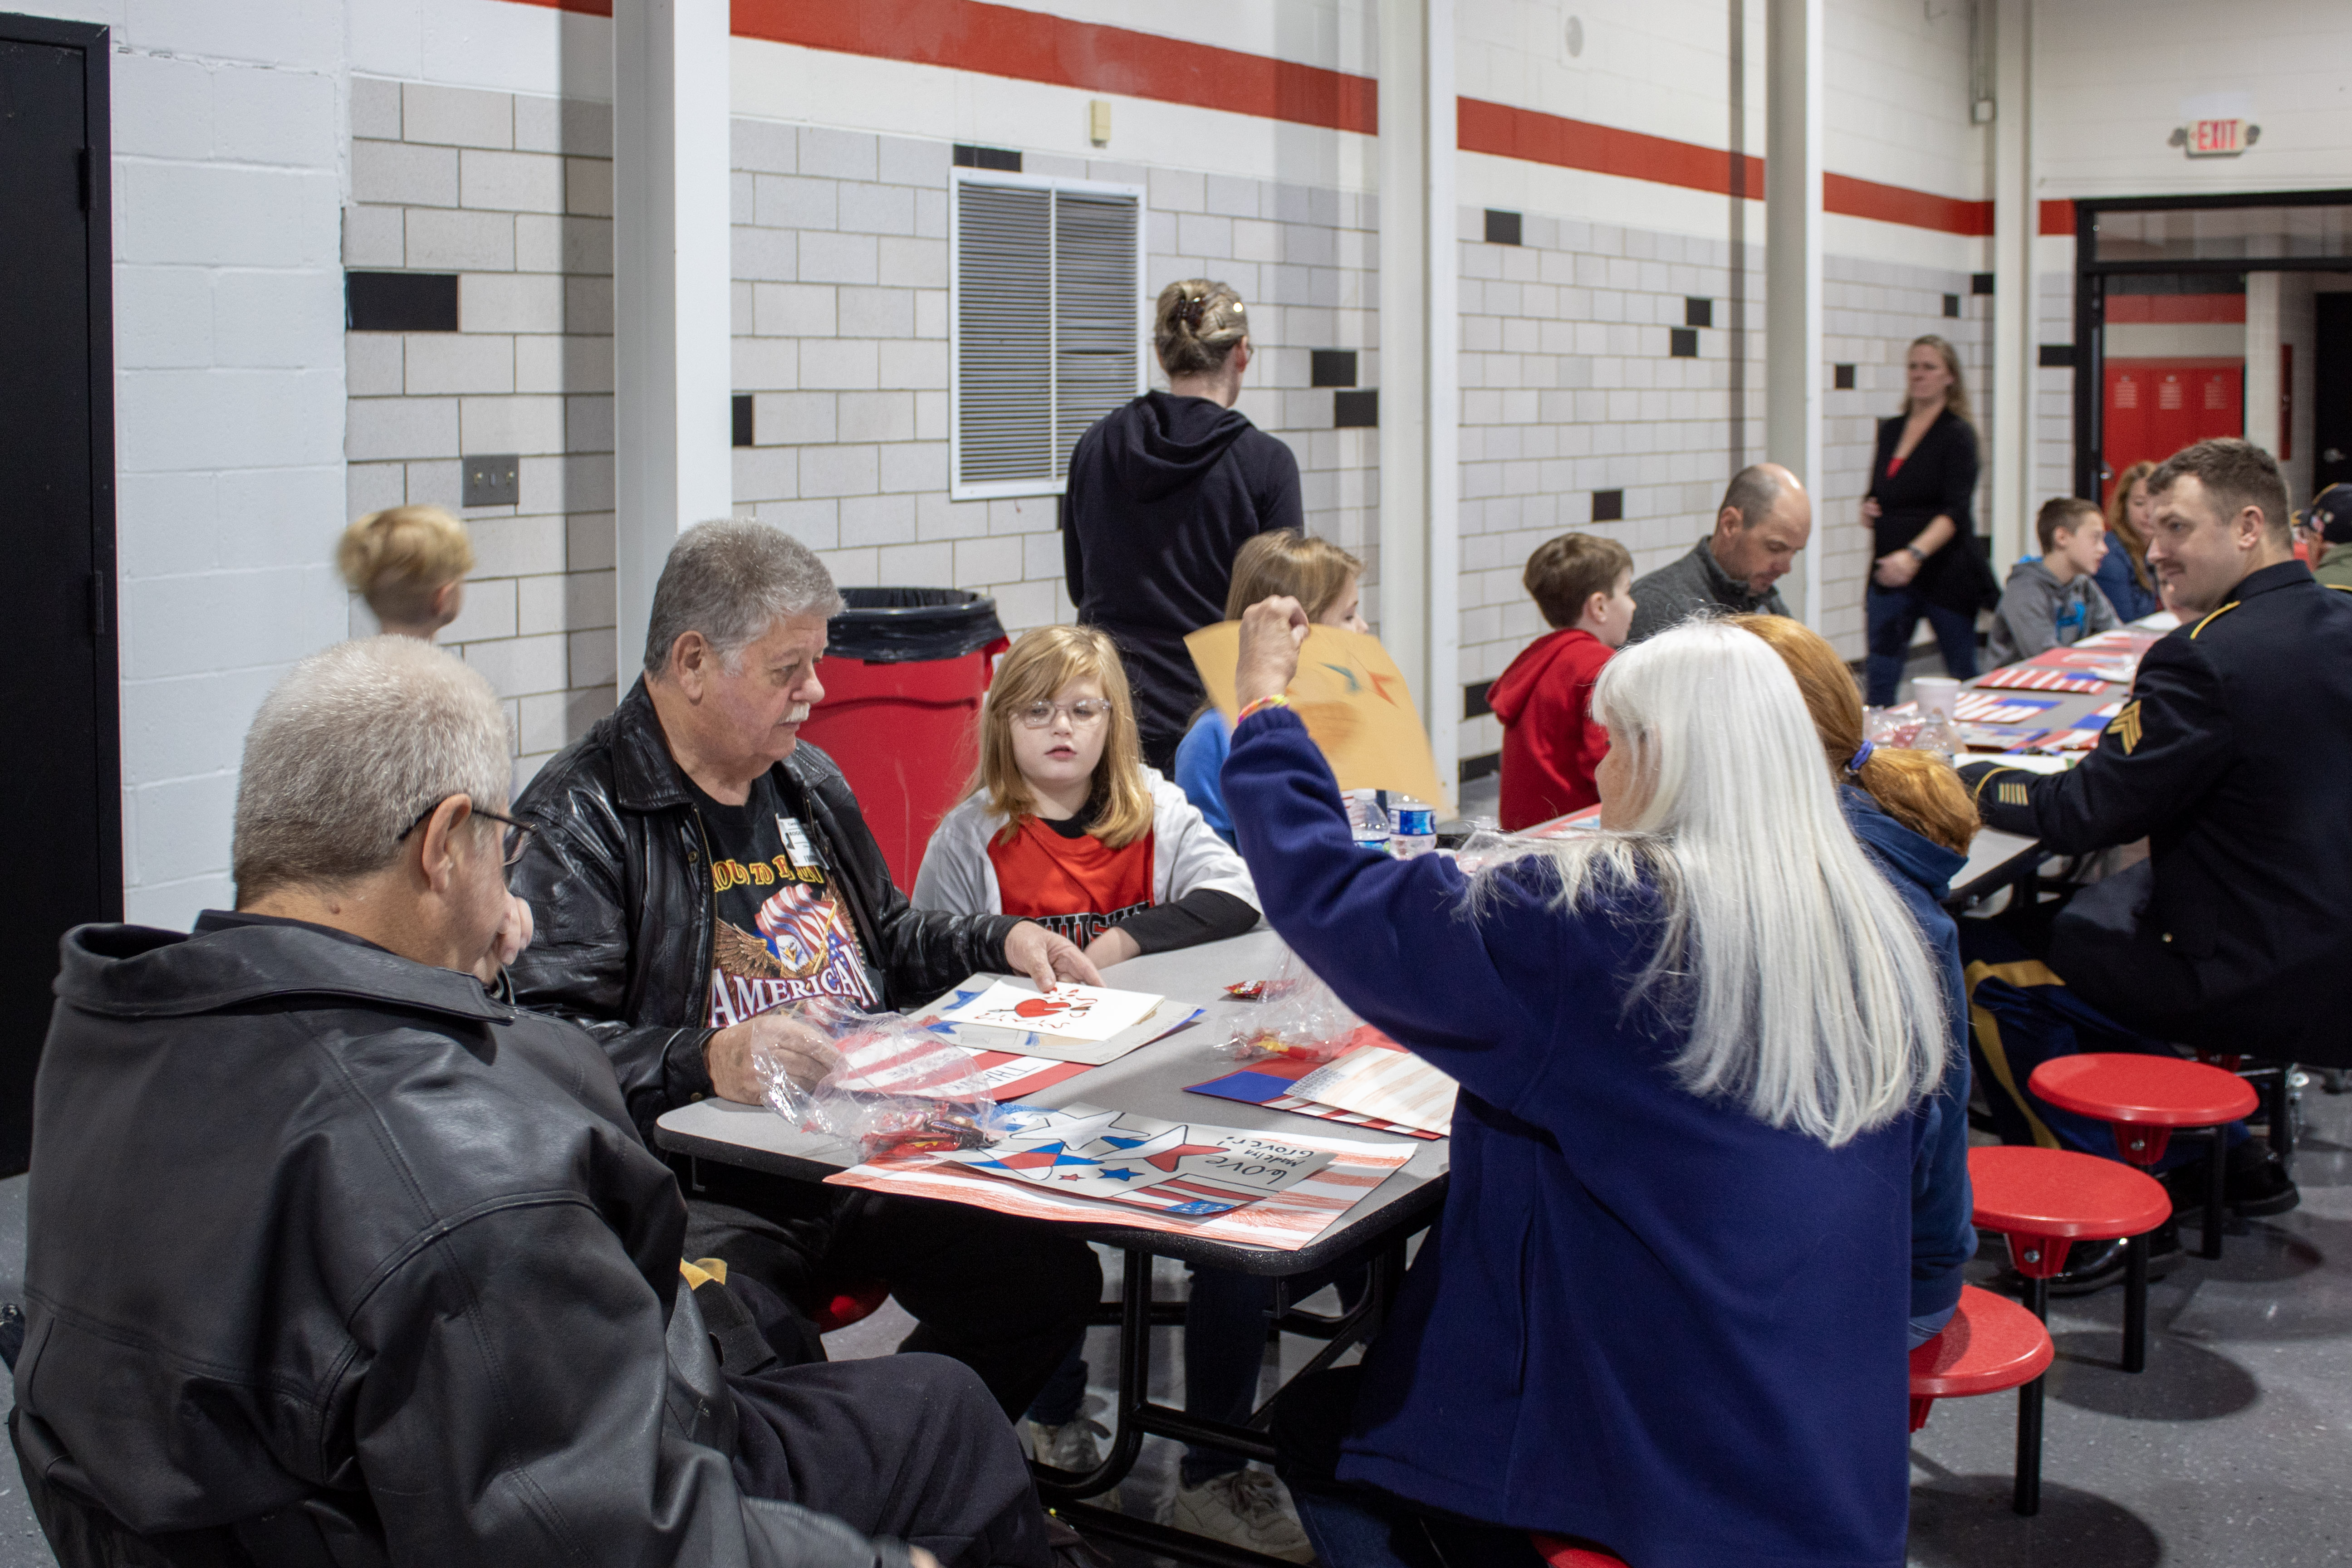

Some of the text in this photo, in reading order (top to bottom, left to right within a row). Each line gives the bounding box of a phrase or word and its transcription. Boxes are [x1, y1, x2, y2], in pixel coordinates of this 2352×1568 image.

[2197, 119, 2238, 151] EXIT
[749, 861, 774, 885] TO
[706, 943, 878, 1028] AMERICAN
